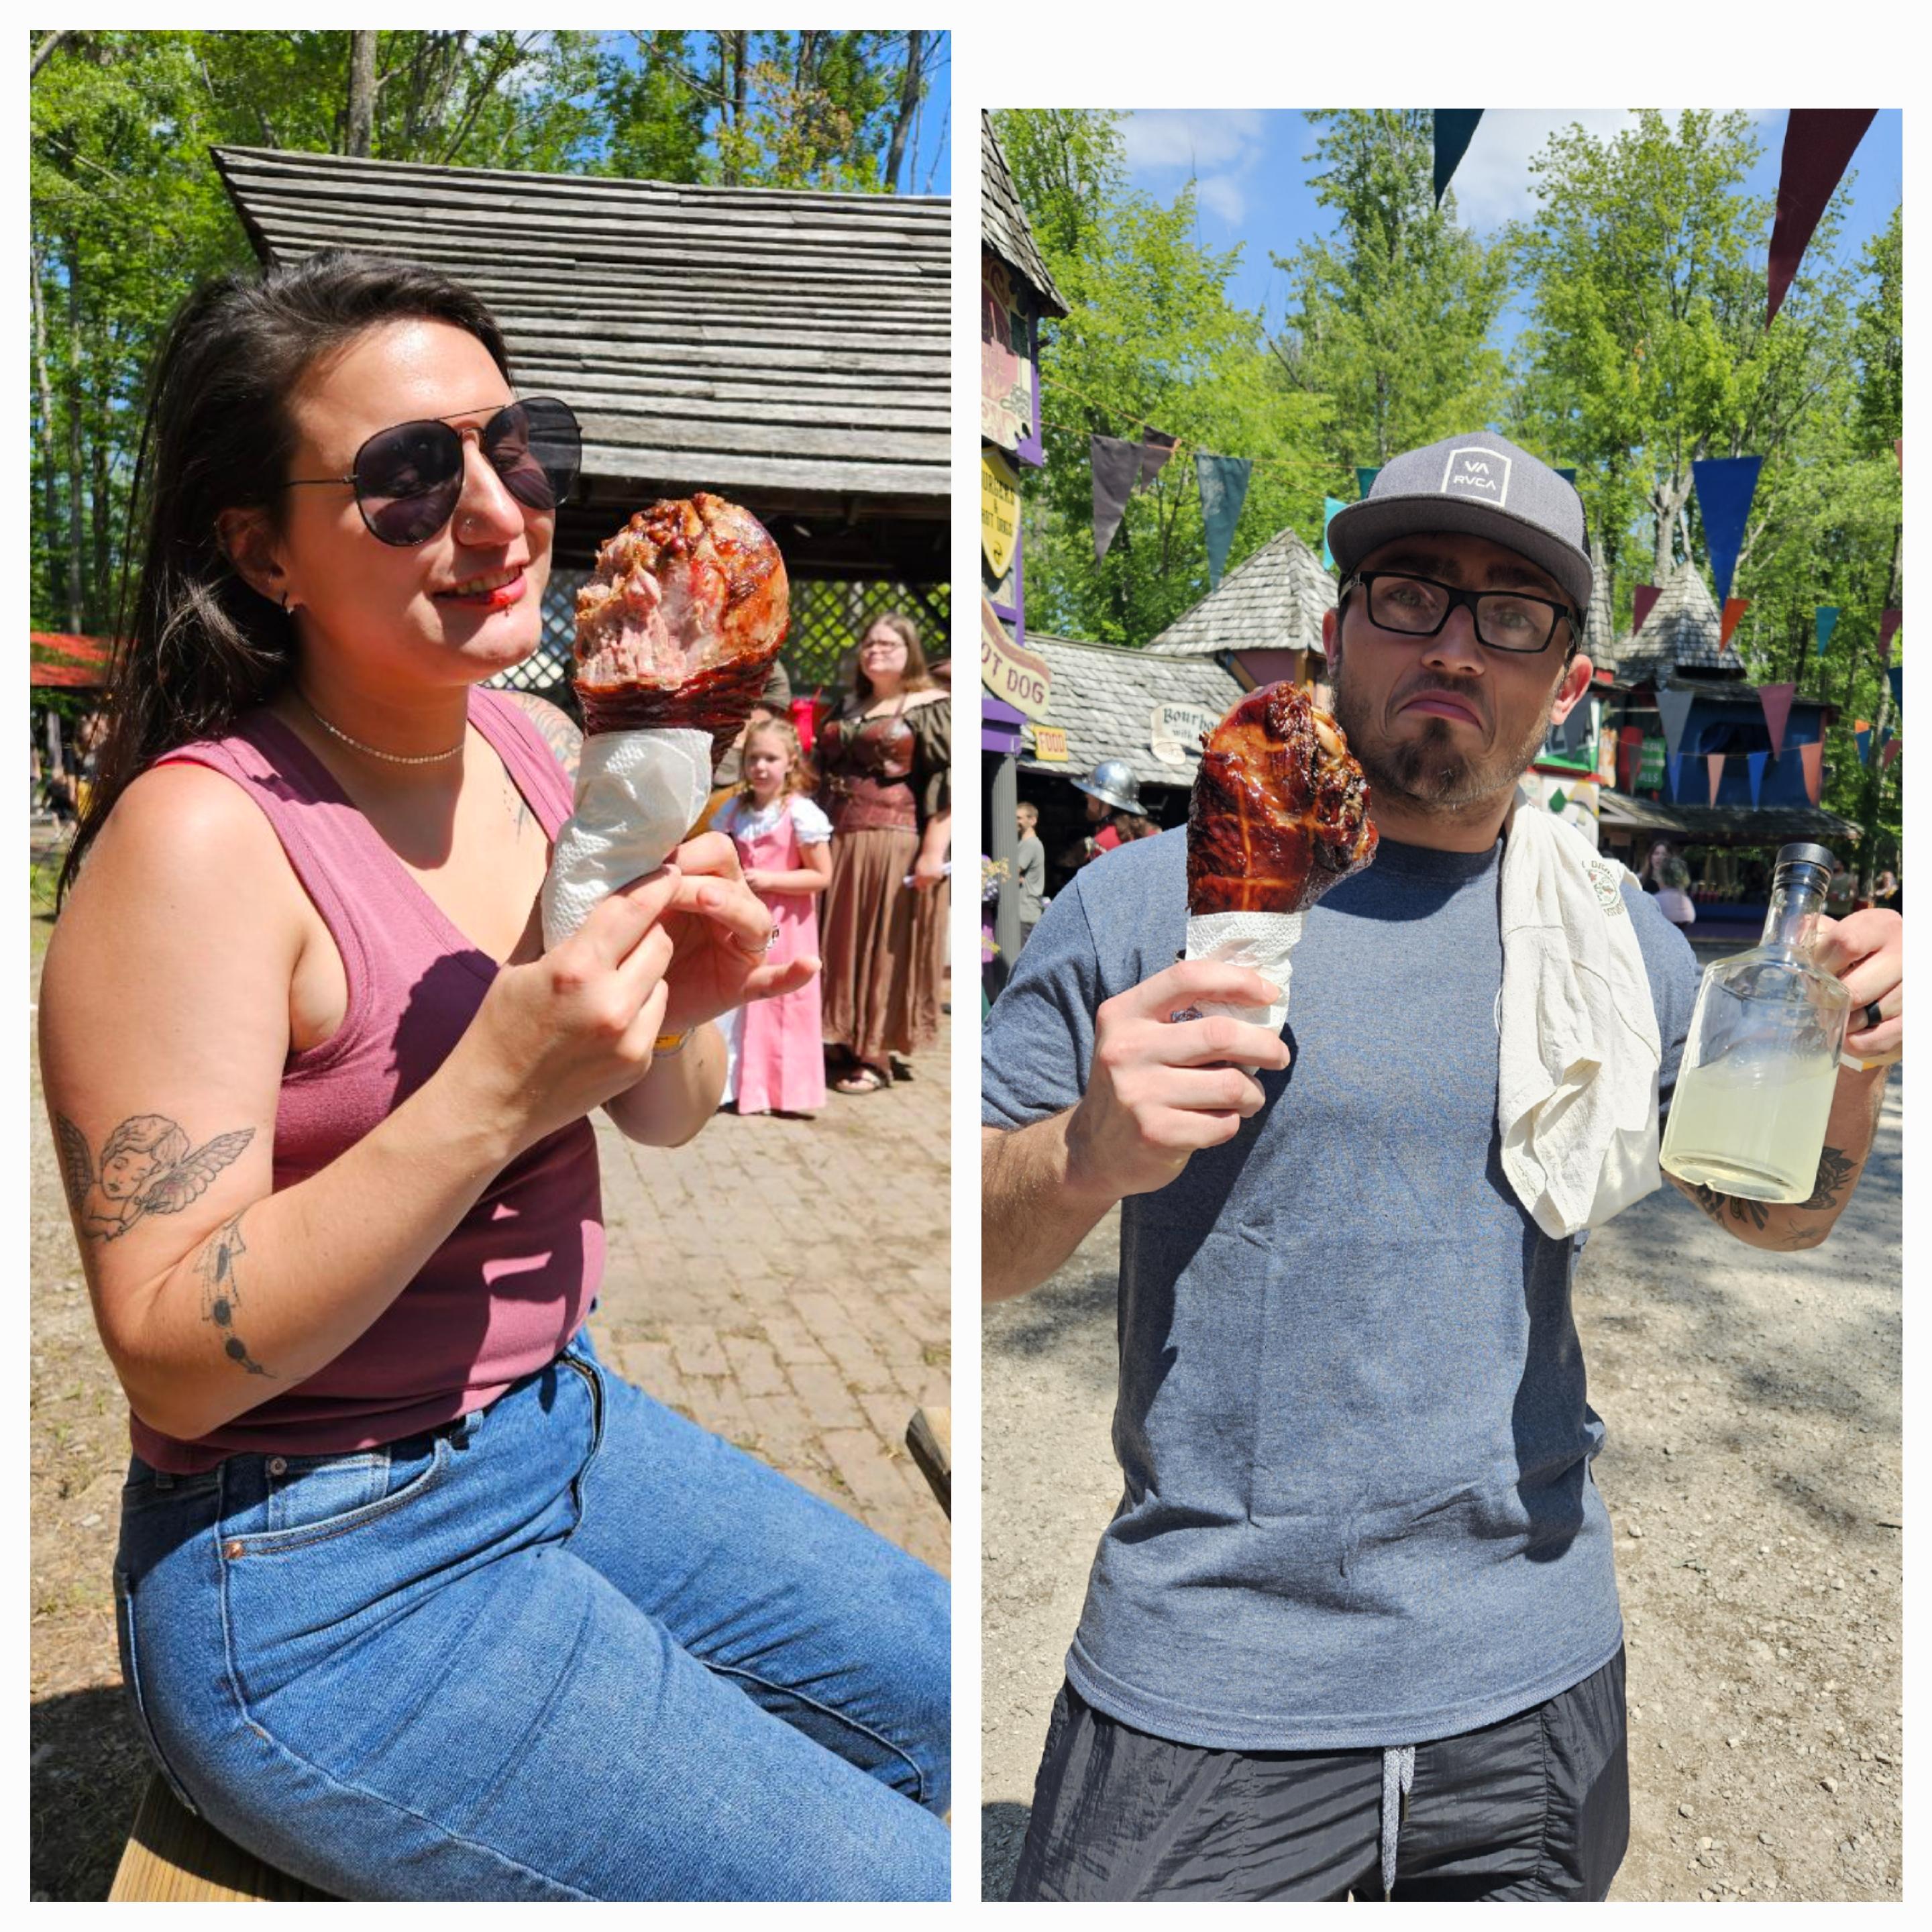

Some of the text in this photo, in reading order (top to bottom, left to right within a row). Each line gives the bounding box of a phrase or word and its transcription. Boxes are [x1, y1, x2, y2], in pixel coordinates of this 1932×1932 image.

[1464, 460, 1489, 475] VA
[1452, 474, 1497, 491] RVCA
[1006, 666, 1045, 705] DOG
[1163, 708, 1220, 732] Bourbo
[1039, 731, 1065, 753] FOOD
